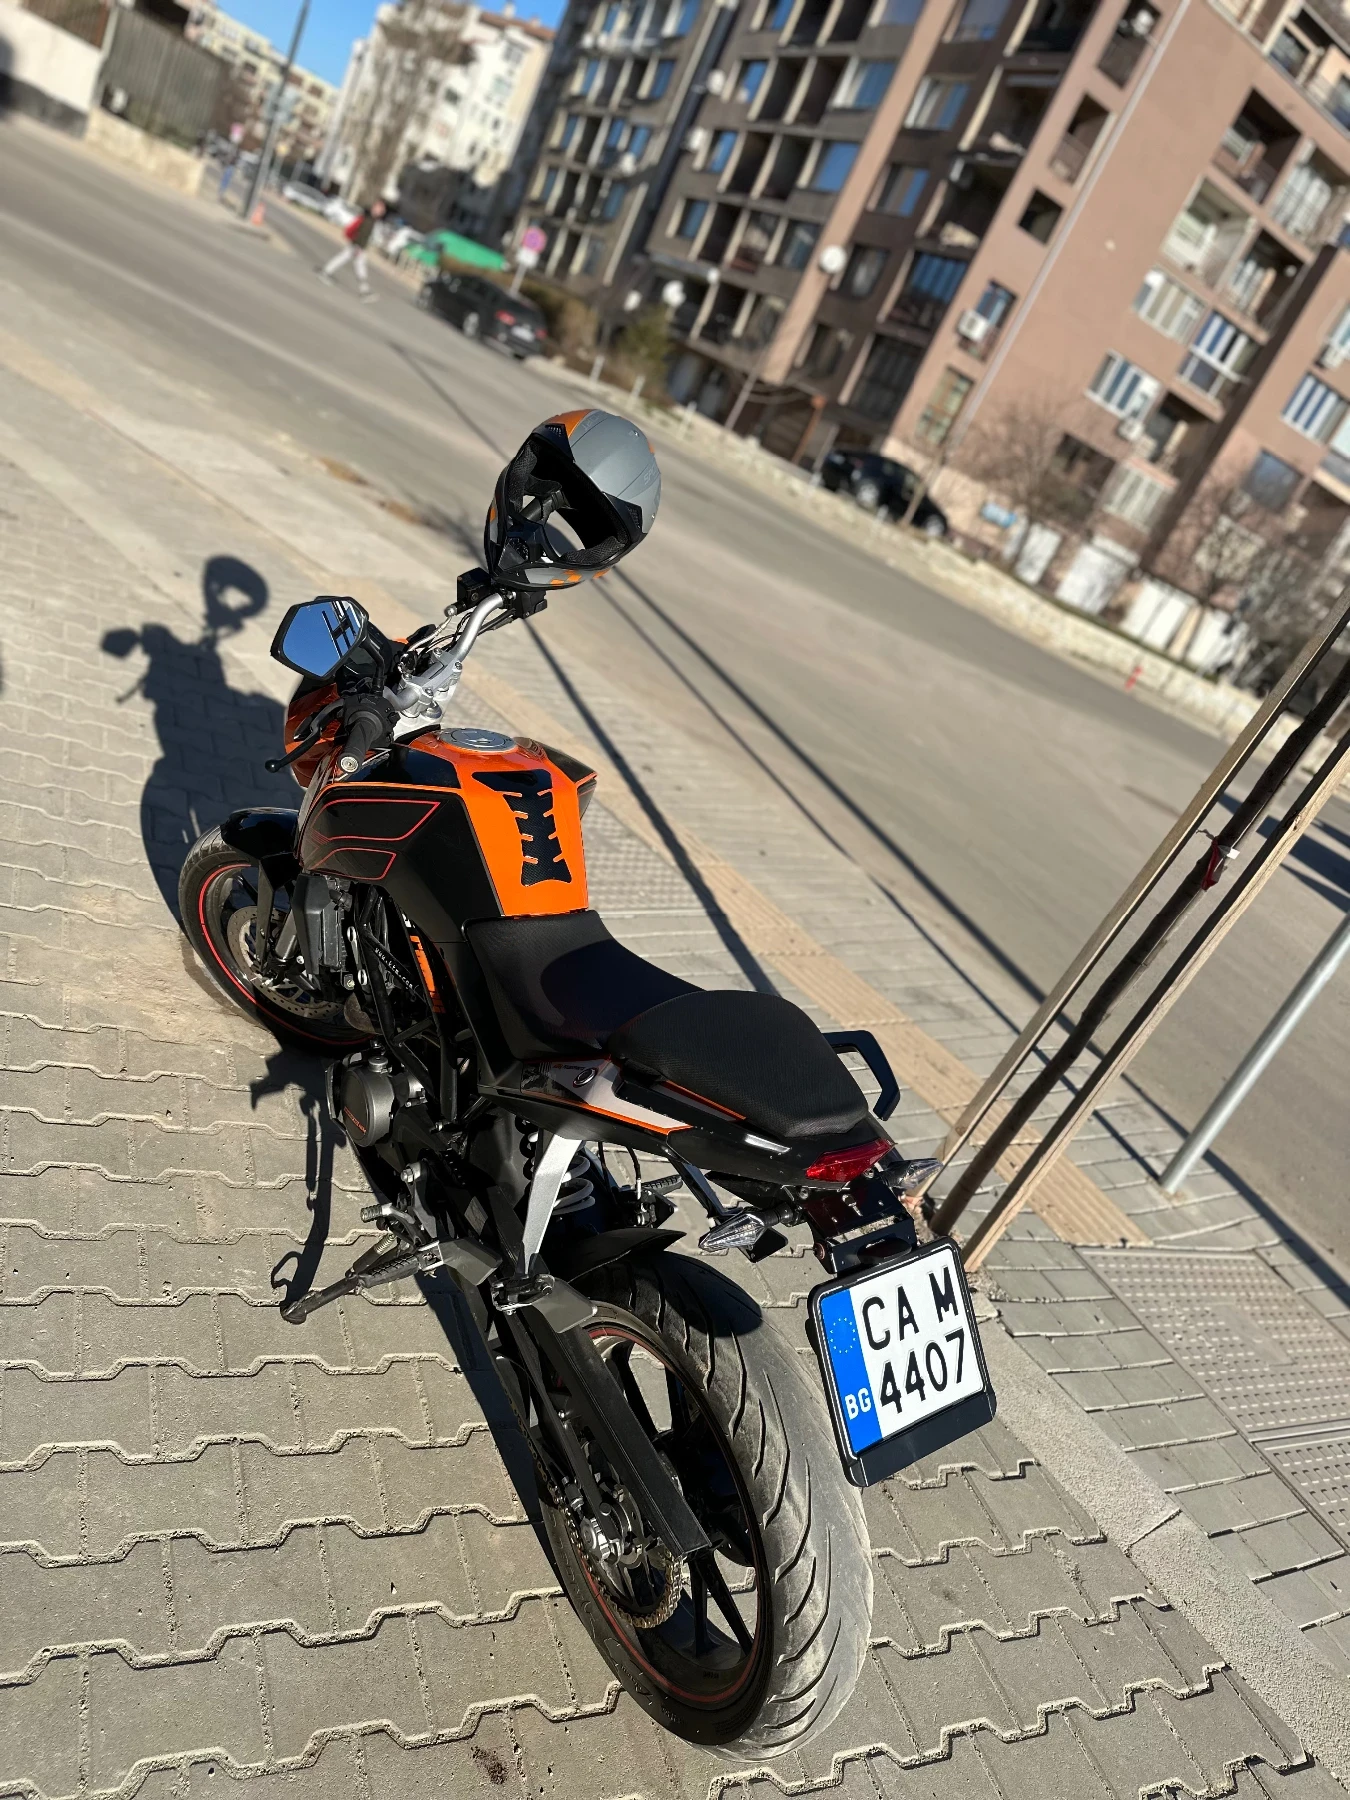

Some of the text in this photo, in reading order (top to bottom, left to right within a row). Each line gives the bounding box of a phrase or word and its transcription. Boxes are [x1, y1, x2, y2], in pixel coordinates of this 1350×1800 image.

[862, 1266, 959, 1350] CA M
[845, 1388, 872, 1420] BG
[880, 1328, 964, 1414] 4407
